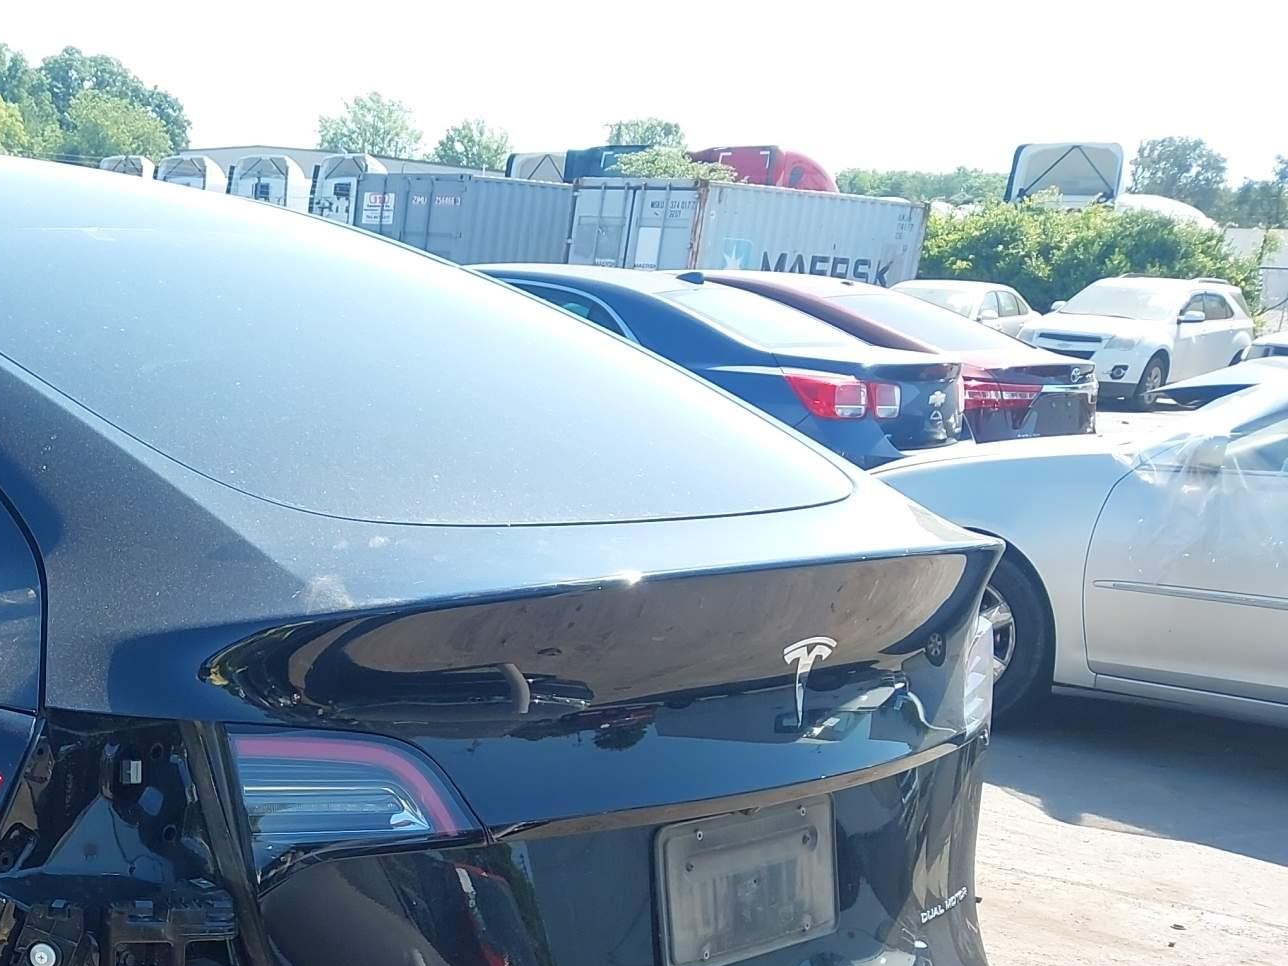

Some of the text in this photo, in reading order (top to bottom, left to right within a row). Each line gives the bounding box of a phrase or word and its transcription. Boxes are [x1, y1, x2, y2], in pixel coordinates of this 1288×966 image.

[760, 251, 895, 288] MAERSK
[920, 886, 969, 924] DUAL MOTOR
